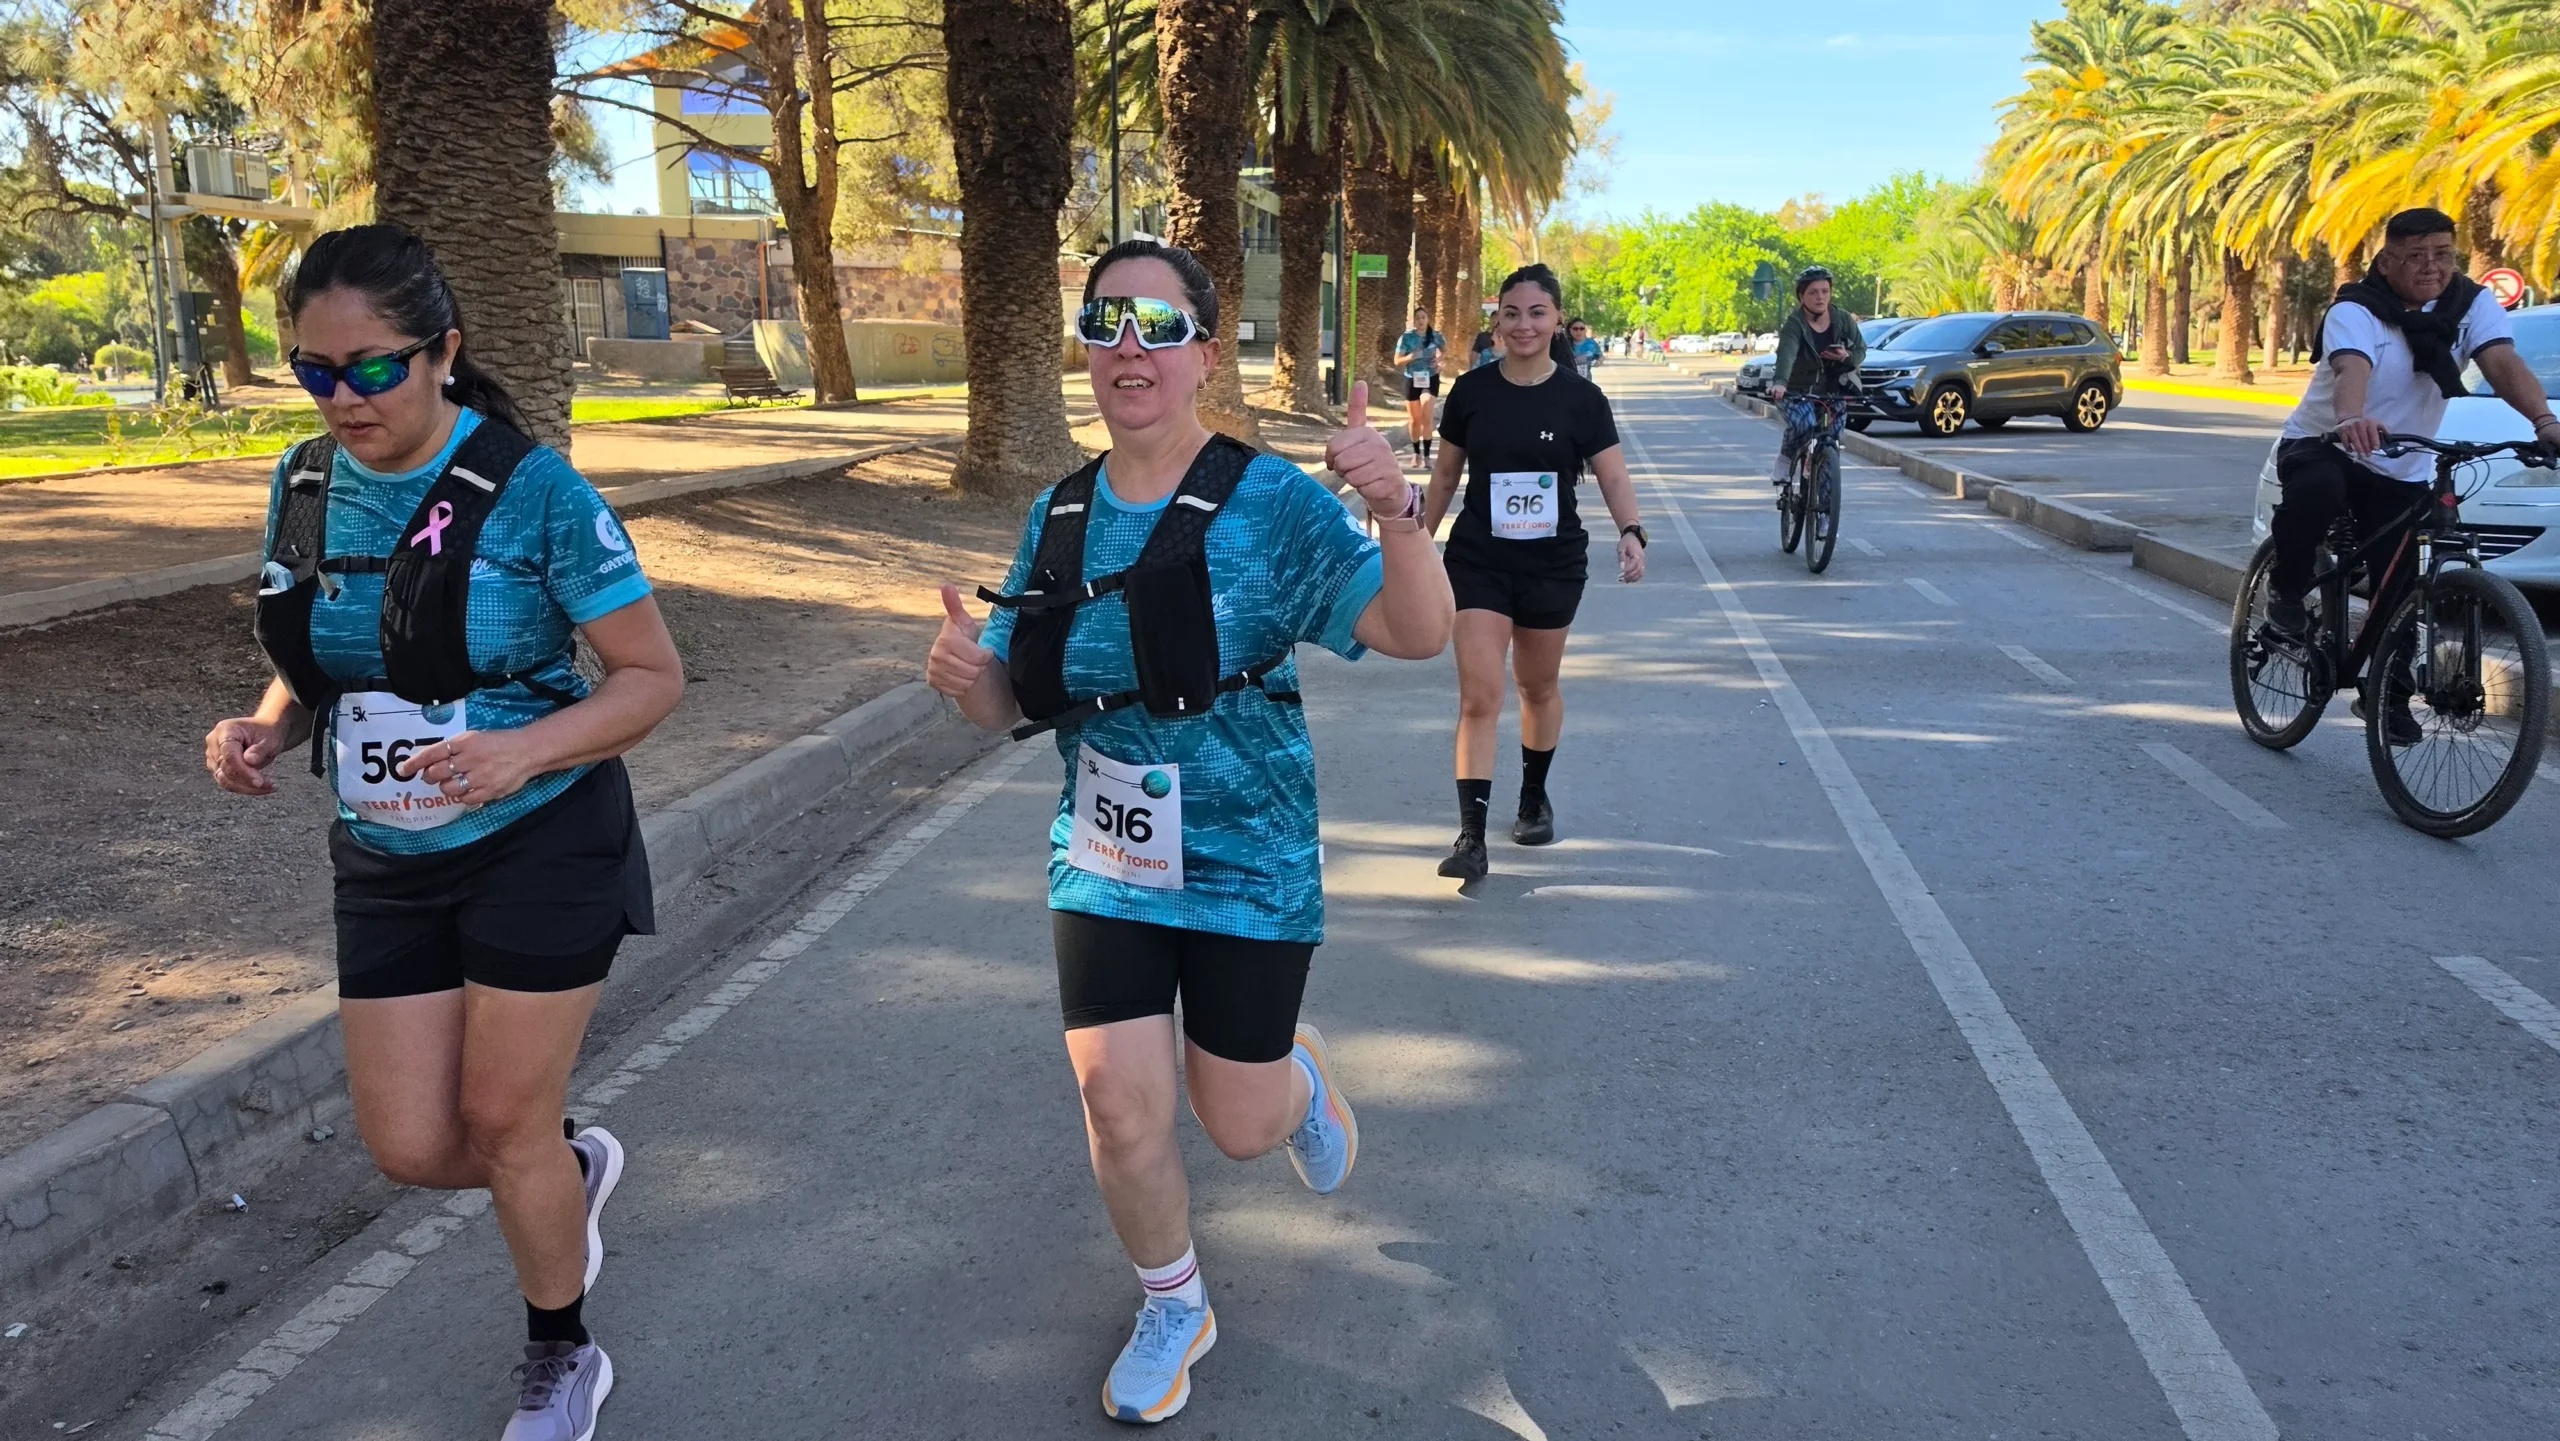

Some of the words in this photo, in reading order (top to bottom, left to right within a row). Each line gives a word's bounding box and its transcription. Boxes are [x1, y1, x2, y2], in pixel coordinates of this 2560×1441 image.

[1505, 494, 1544, 516] 616
[1094, 793, 1153, 844] 516
[1087, 838, 1169, 871] TERRITORIO
